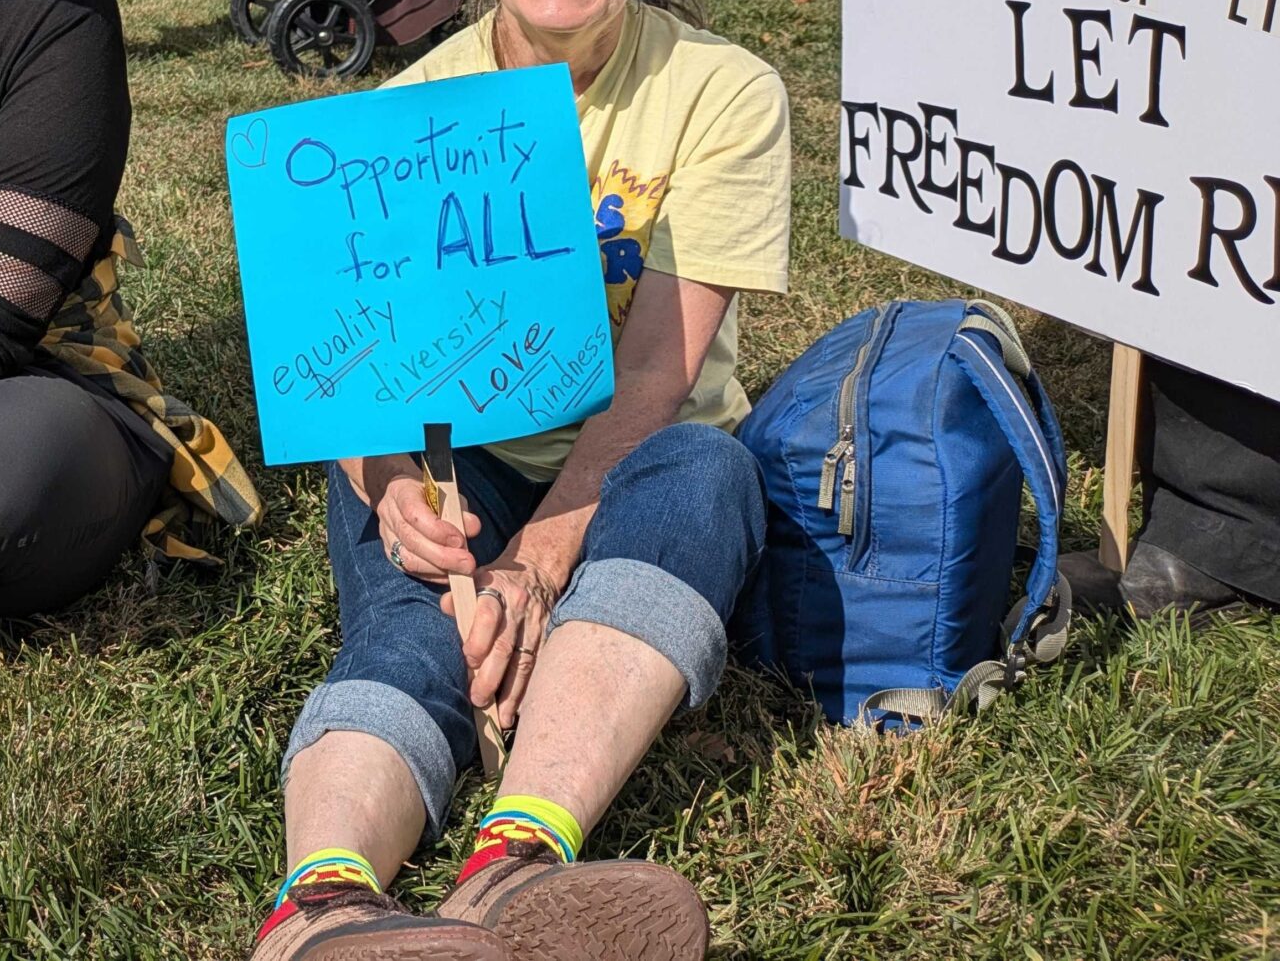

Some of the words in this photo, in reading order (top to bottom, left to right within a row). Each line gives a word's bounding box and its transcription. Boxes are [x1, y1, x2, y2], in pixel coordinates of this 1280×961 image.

[1005, 0, 1186, 128] LET
[286, 109, 537, 220] Opportunity
[842, 101, 1164, 296] FREEDOM
[337, 232, 411, 282] for
[436, 191, 575, 270] ALL
[272, 299, 396, 398] equality
[372, 290, 506, 403] diversity
[459, 322, 555, 414] Love
